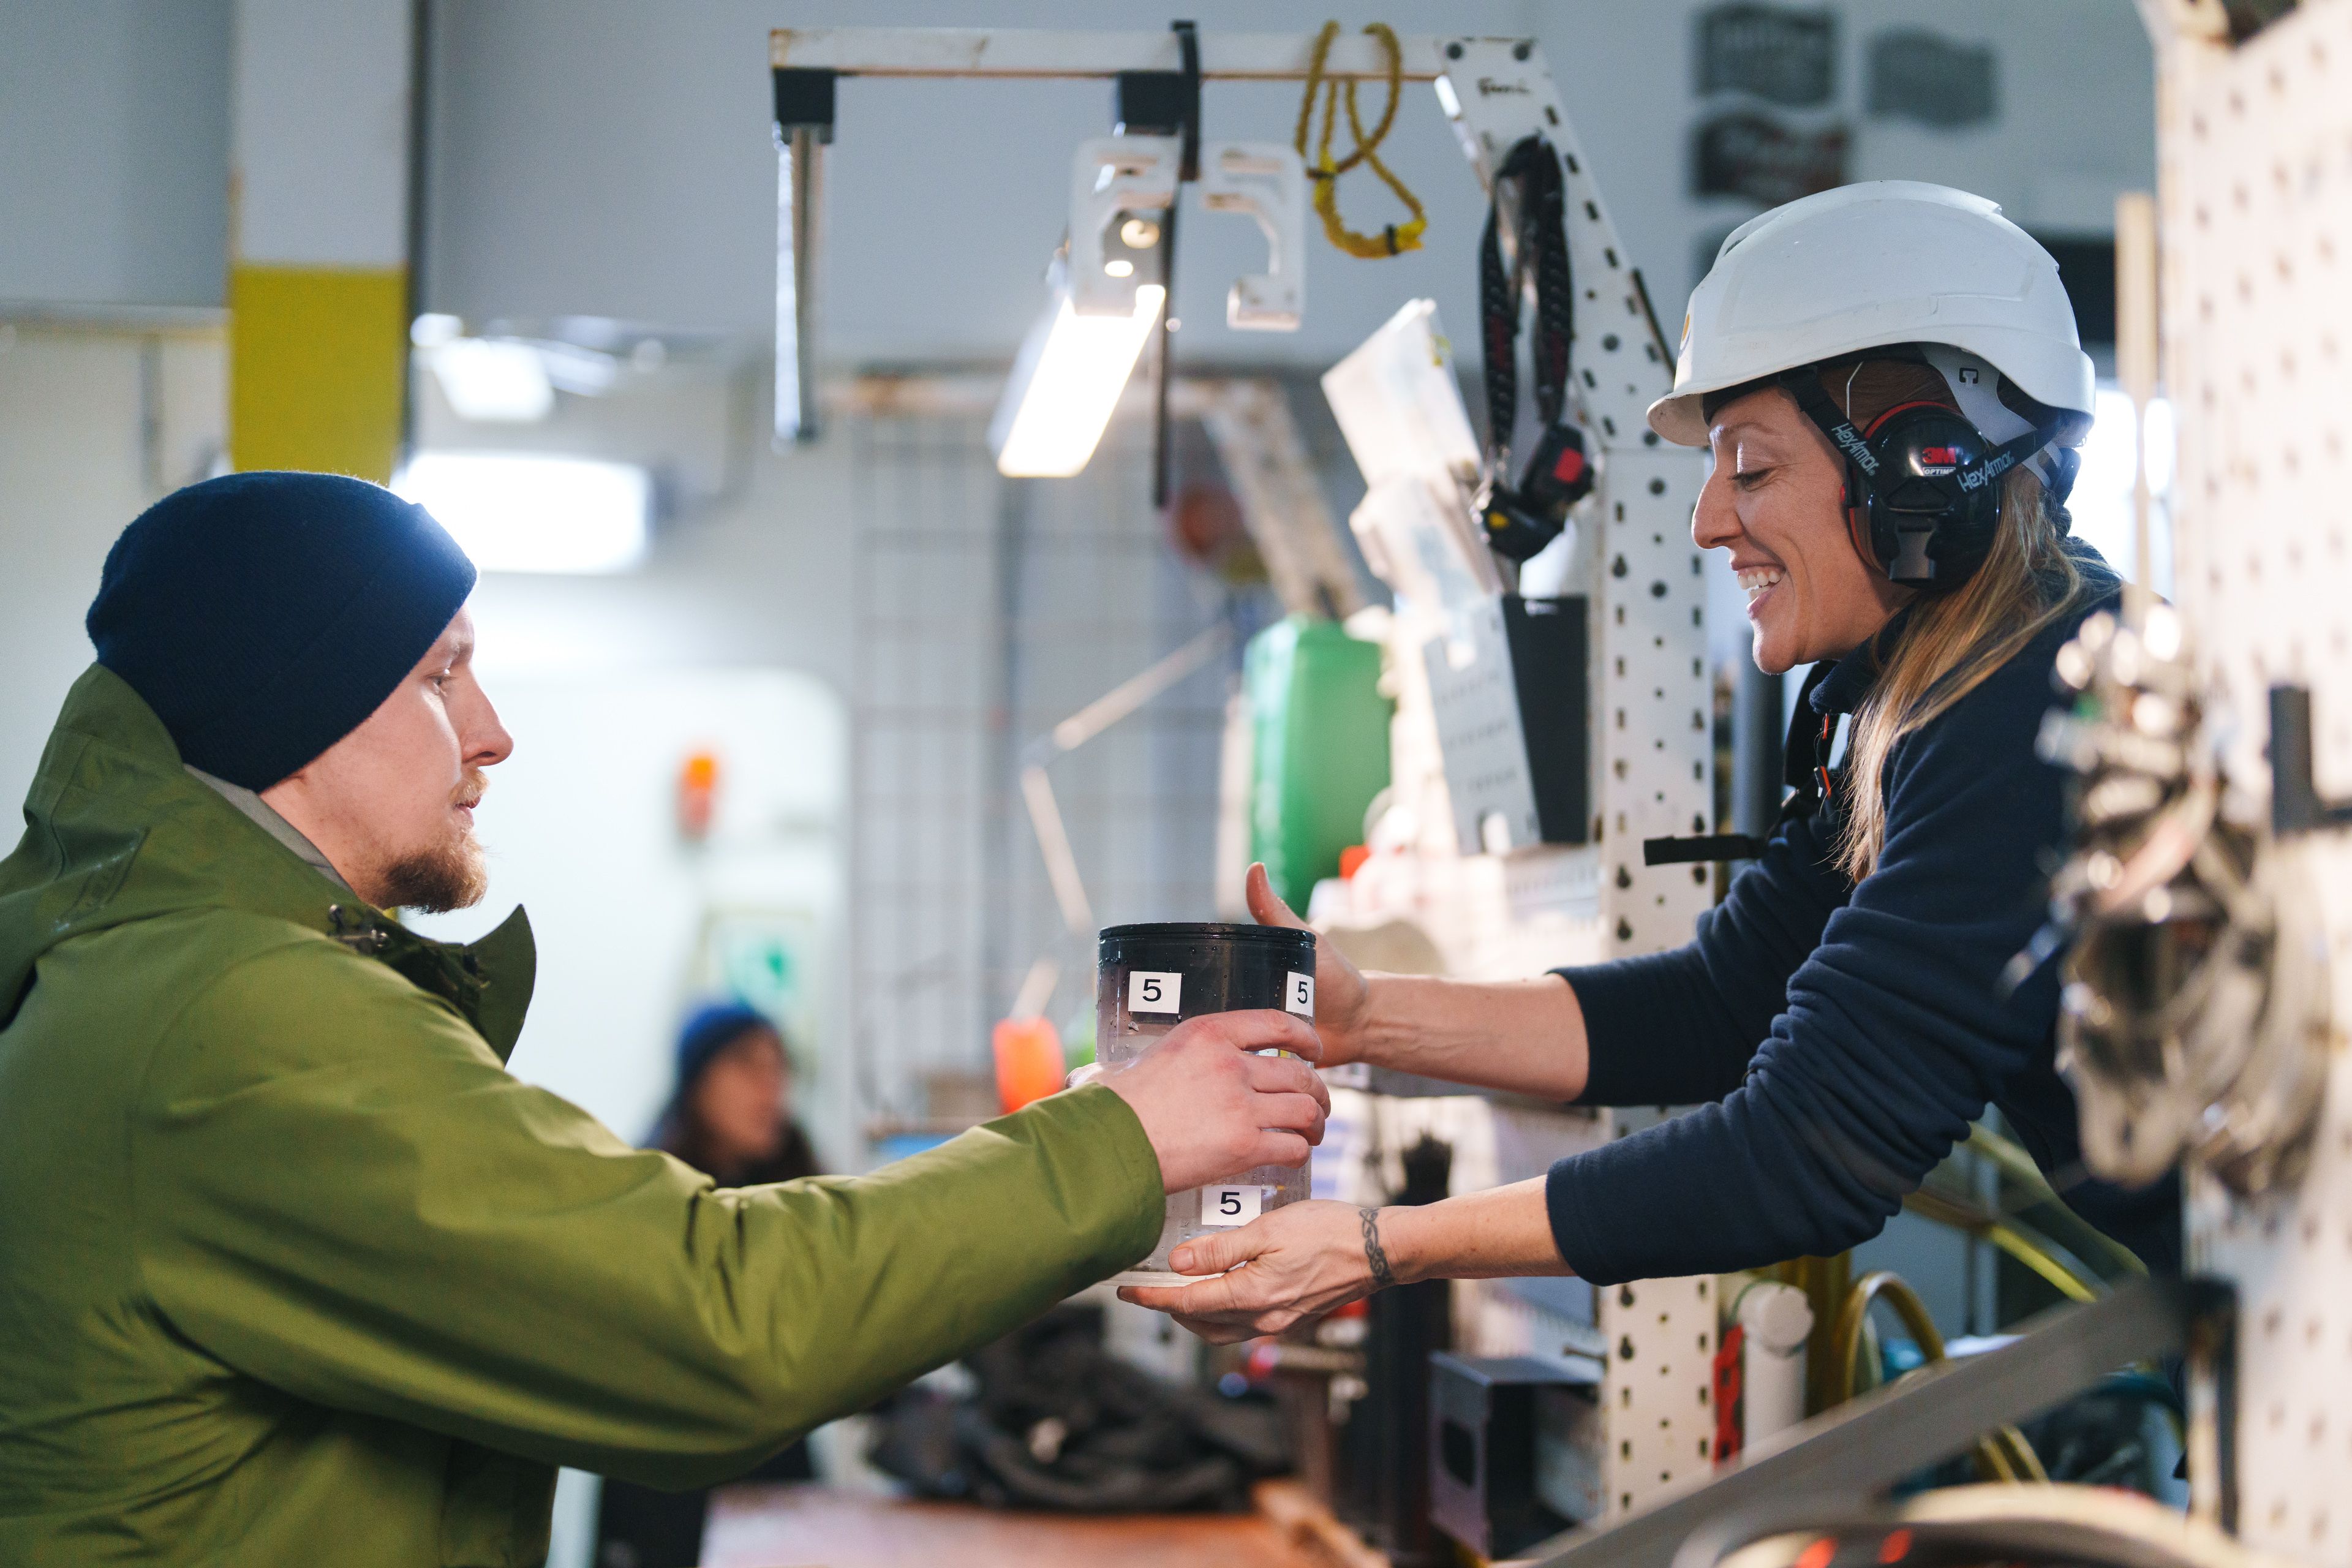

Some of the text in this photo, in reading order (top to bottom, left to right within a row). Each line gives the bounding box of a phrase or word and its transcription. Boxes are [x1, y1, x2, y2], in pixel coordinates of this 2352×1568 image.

[1922, 447, 1956, 464] 3M
[1142, 978, 1162, 1002] 5
[1297, 981, 1308, 1005] 5
[1219, 1191, 1242, 1215] 5
